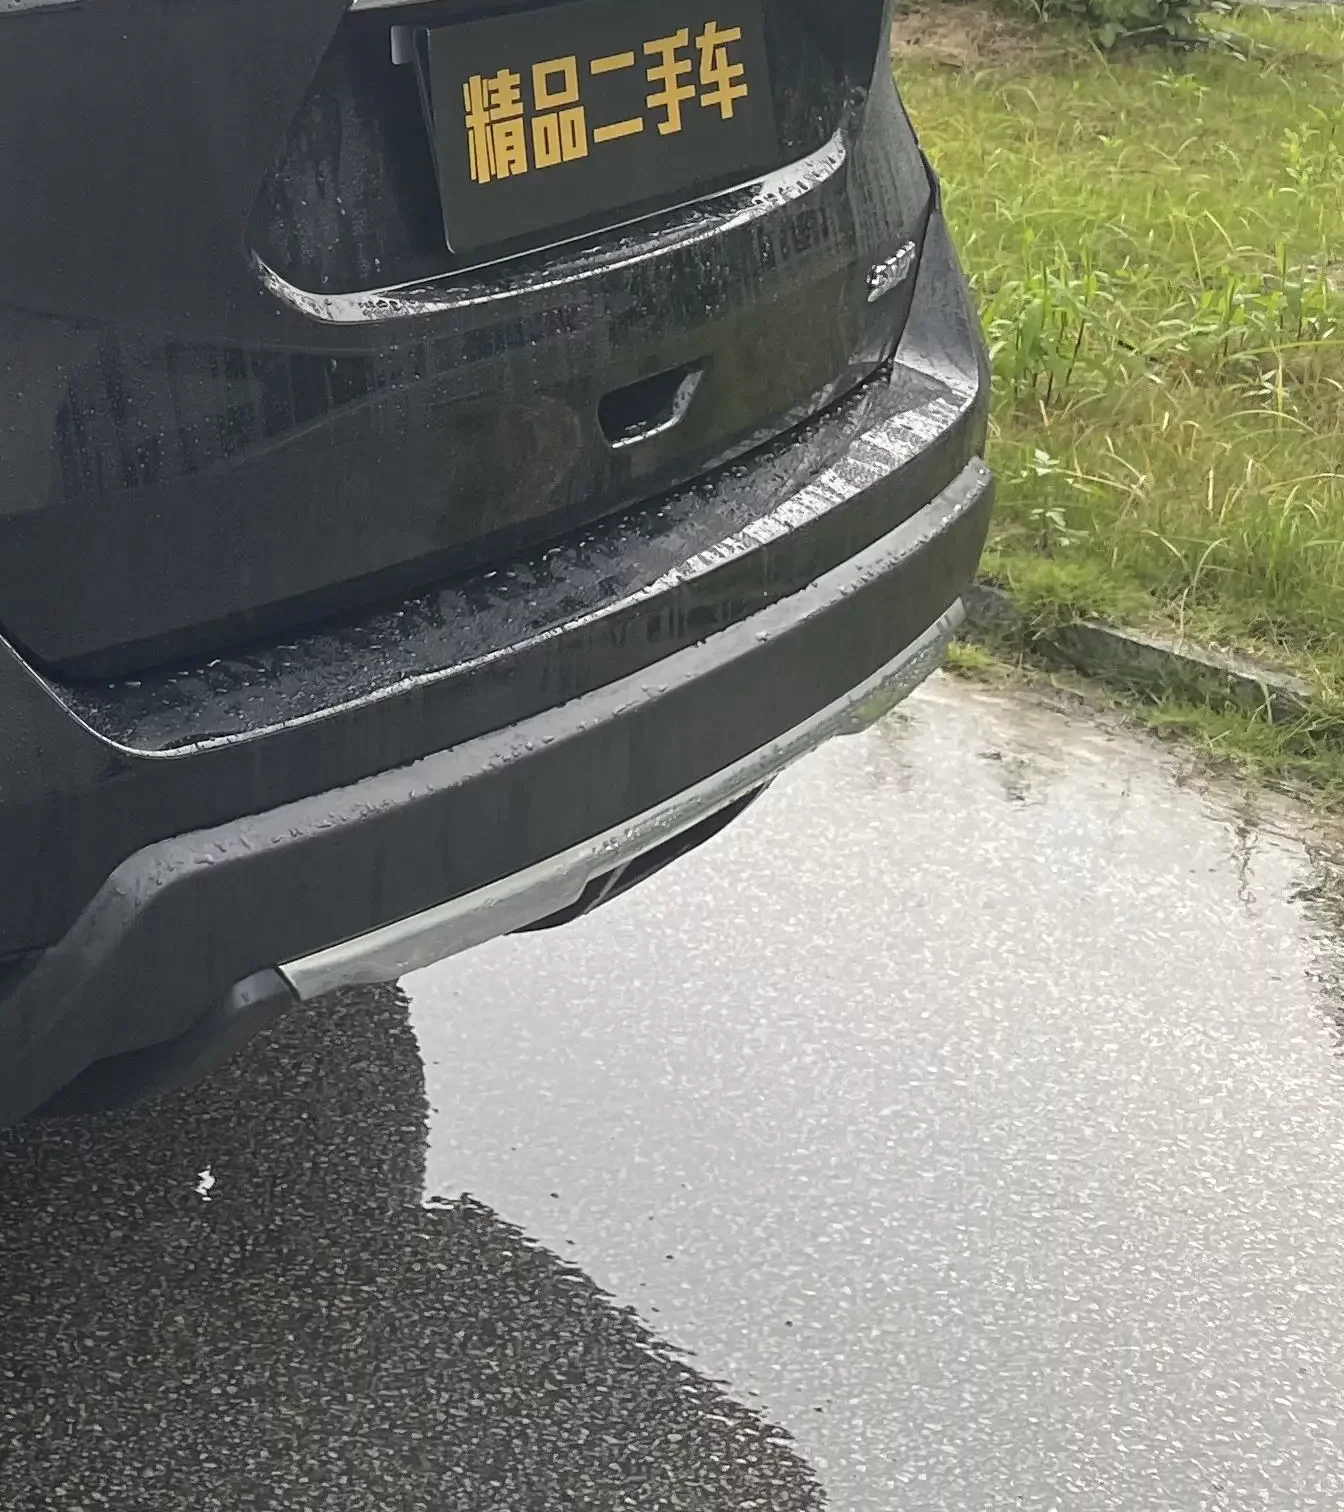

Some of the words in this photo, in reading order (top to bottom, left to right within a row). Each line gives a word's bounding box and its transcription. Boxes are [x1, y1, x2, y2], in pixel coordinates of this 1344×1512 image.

[463, 21, 748, 184] 精品二手车
